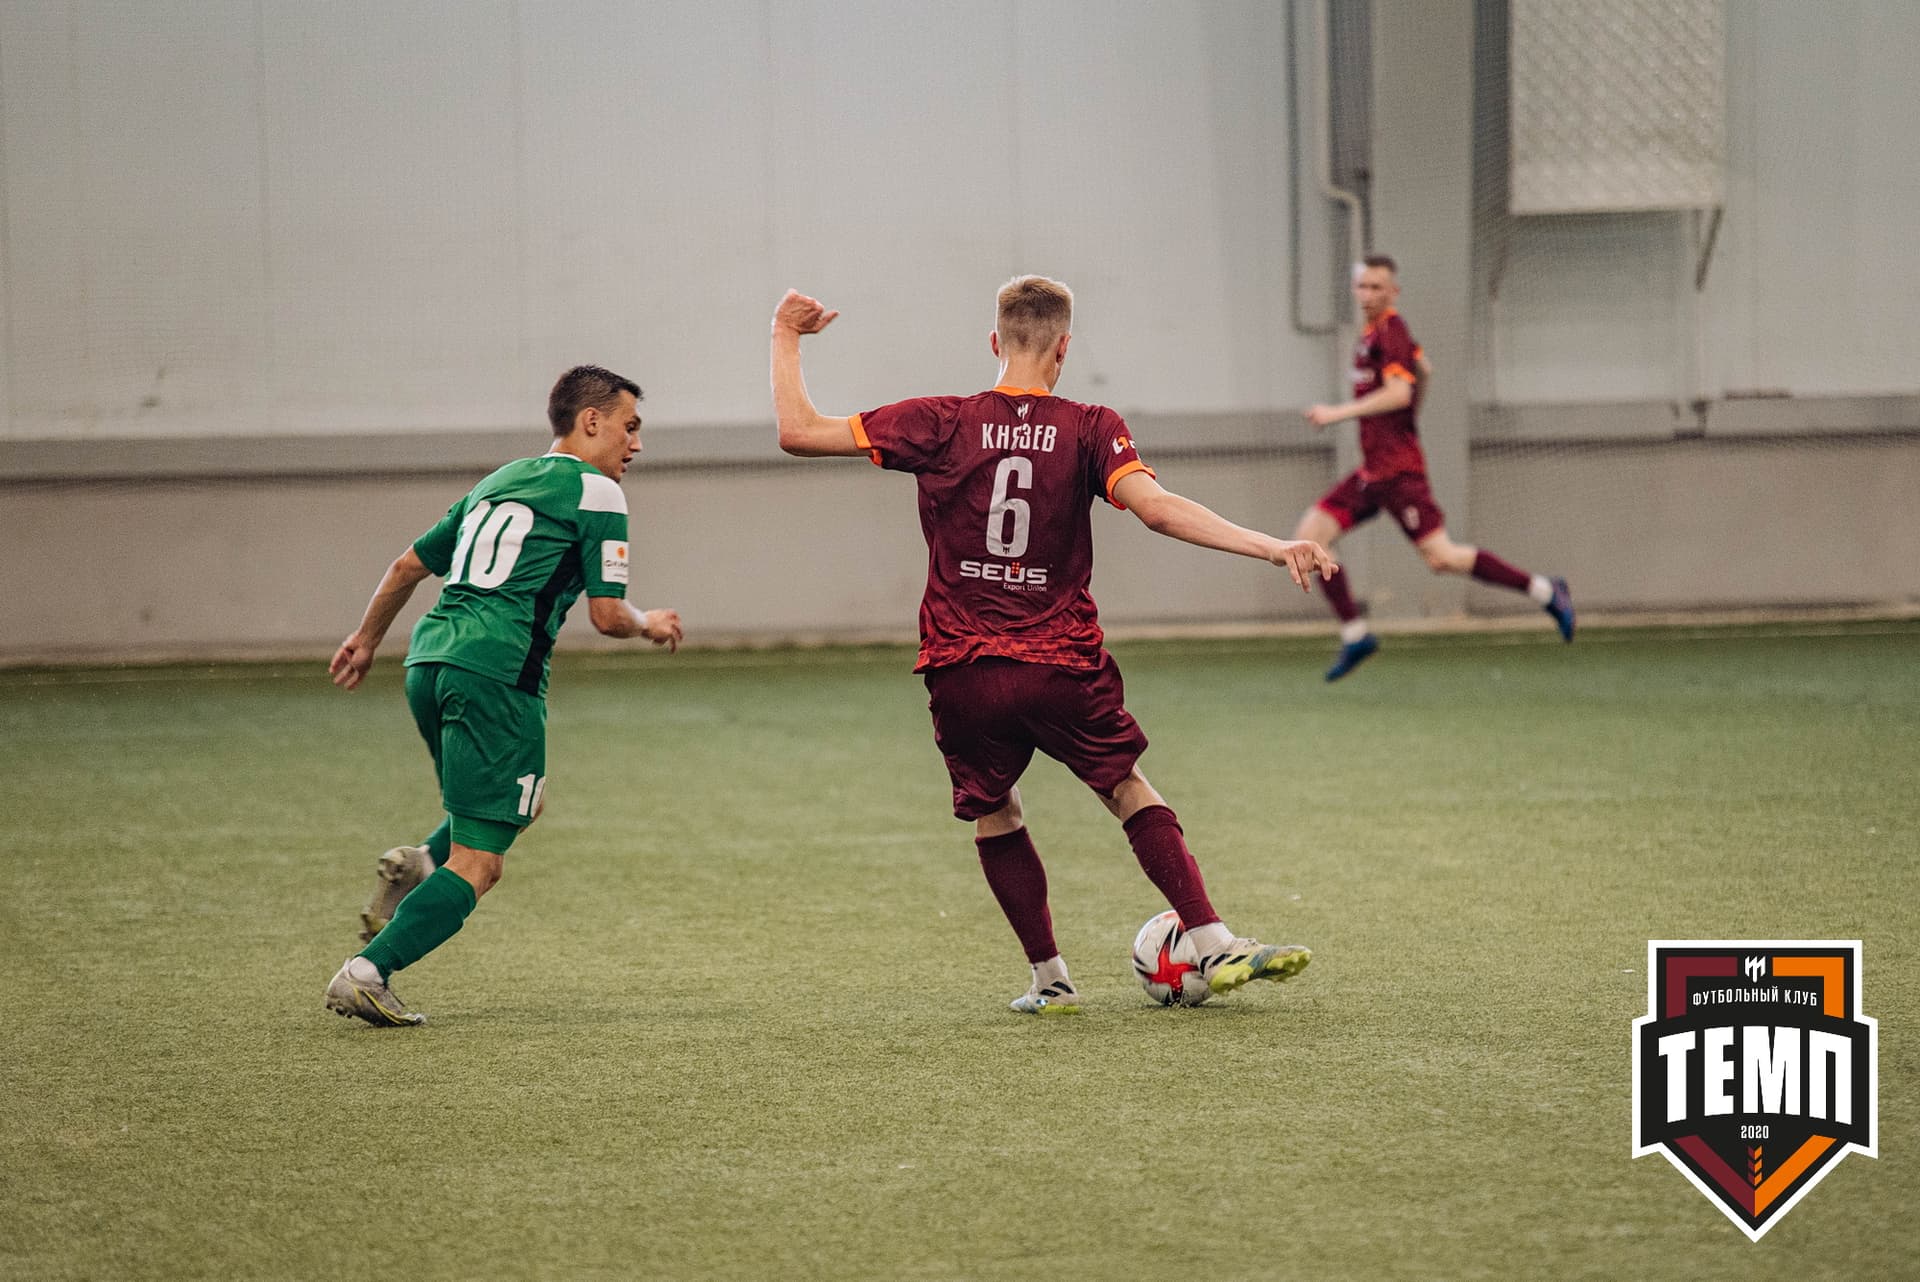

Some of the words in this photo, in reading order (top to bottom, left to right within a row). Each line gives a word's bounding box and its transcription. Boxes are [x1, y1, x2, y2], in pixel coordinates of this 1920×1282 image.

[982, 423, 1057, 453] КНЯЗЕВ
[986, 456, 1033, 557] 6
[445, 500, 534, 589] 10
[1003, 582, 1026, 592] Export
[1027, 584, 1048, 592] Union
